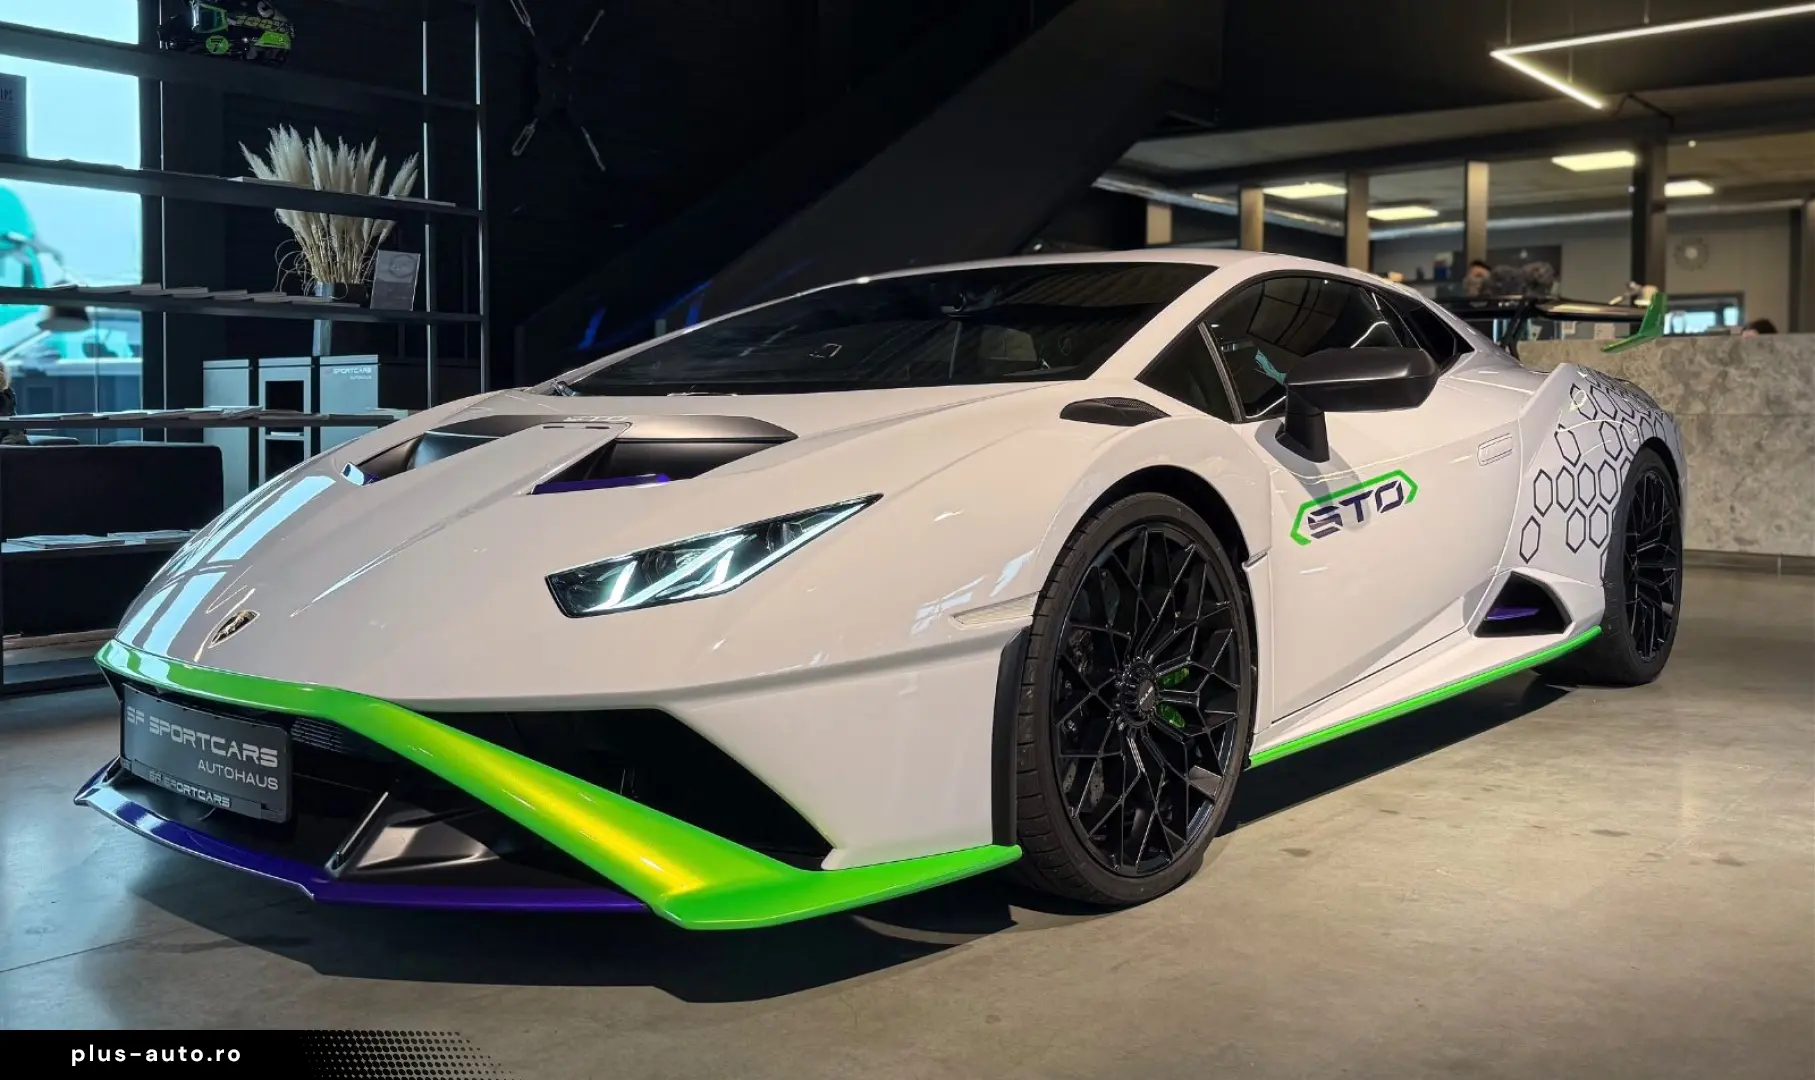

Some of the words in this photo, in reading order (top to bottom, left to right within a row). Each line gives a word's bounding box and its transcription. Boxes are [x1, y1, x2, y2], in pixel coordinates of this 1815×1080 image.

[1307, 480, 1404, 539] STO
[127, 706, 145, 725] SF
[149, 715, 278, 768] SPORTCARS
[197, 759, 278, 790] AUTOHAUS
